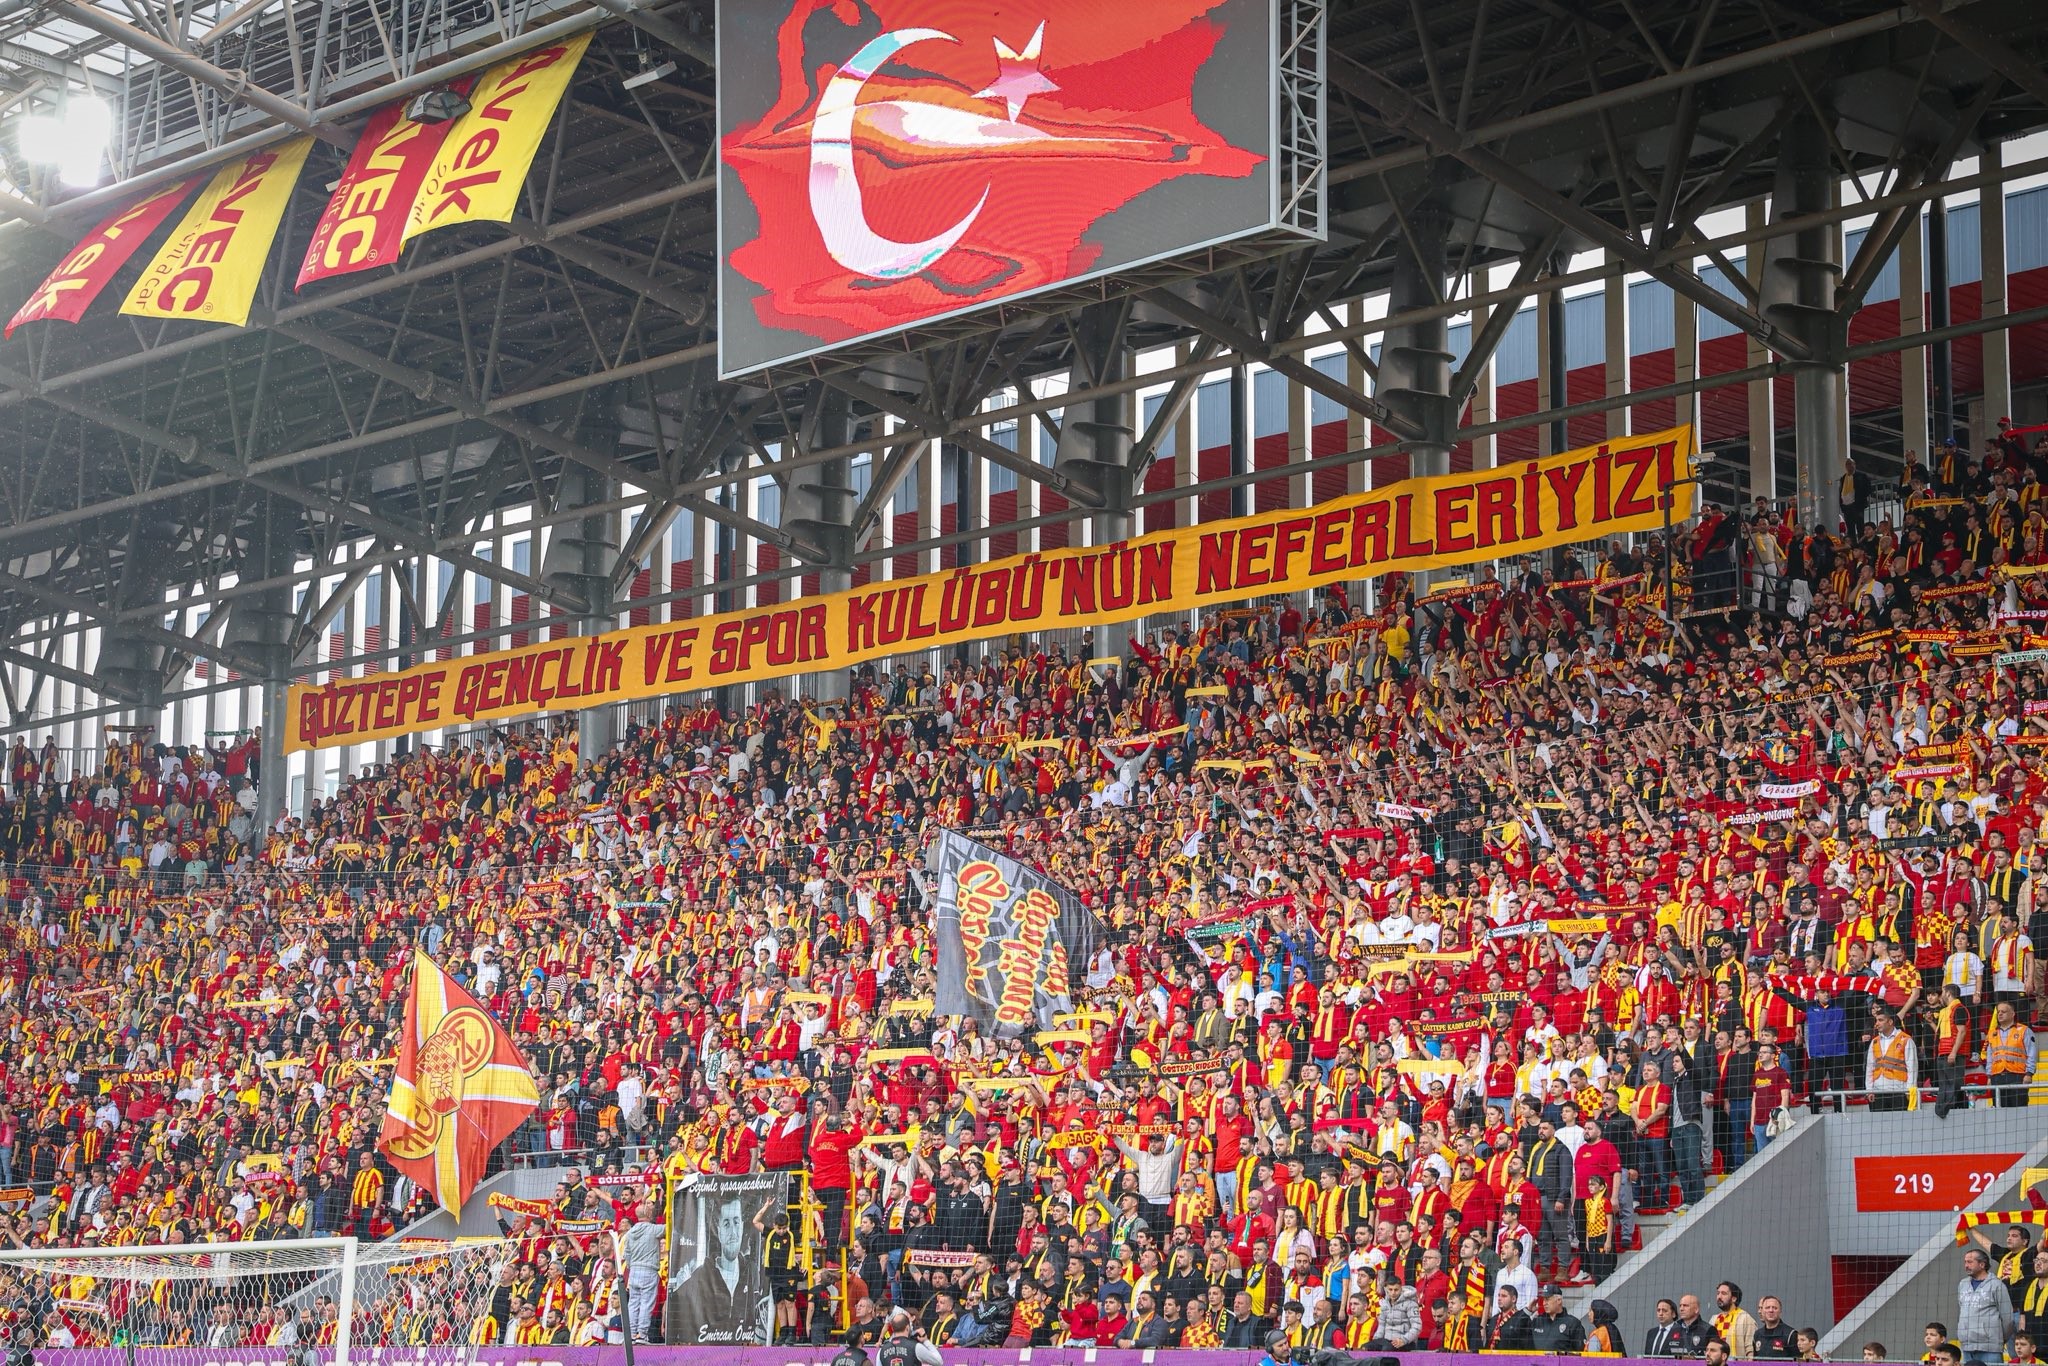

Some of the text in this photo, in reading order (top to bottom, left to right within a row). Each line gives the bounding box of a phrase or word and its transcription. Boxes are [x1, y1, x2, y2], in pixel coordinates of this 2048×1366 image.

[324, 97, 424, 269] VEC
[157, 153, 279, 313] AVEC
[299, 440, 1678, 748] GÖZTEPE GENÇLİK VE SPOR KULÜBÜ'NÜN NEFERLERİYİZ!
[1111, 1124, 1135, 1132] FORZA
[598, 1175, 645, 1184] GÖZTEPE
[1894, 1172, 2004, 1193] 219 22
[913, 1253, 974, 1265] GÖZTEPE
[698, 1324, 733, 1343] Emircan
